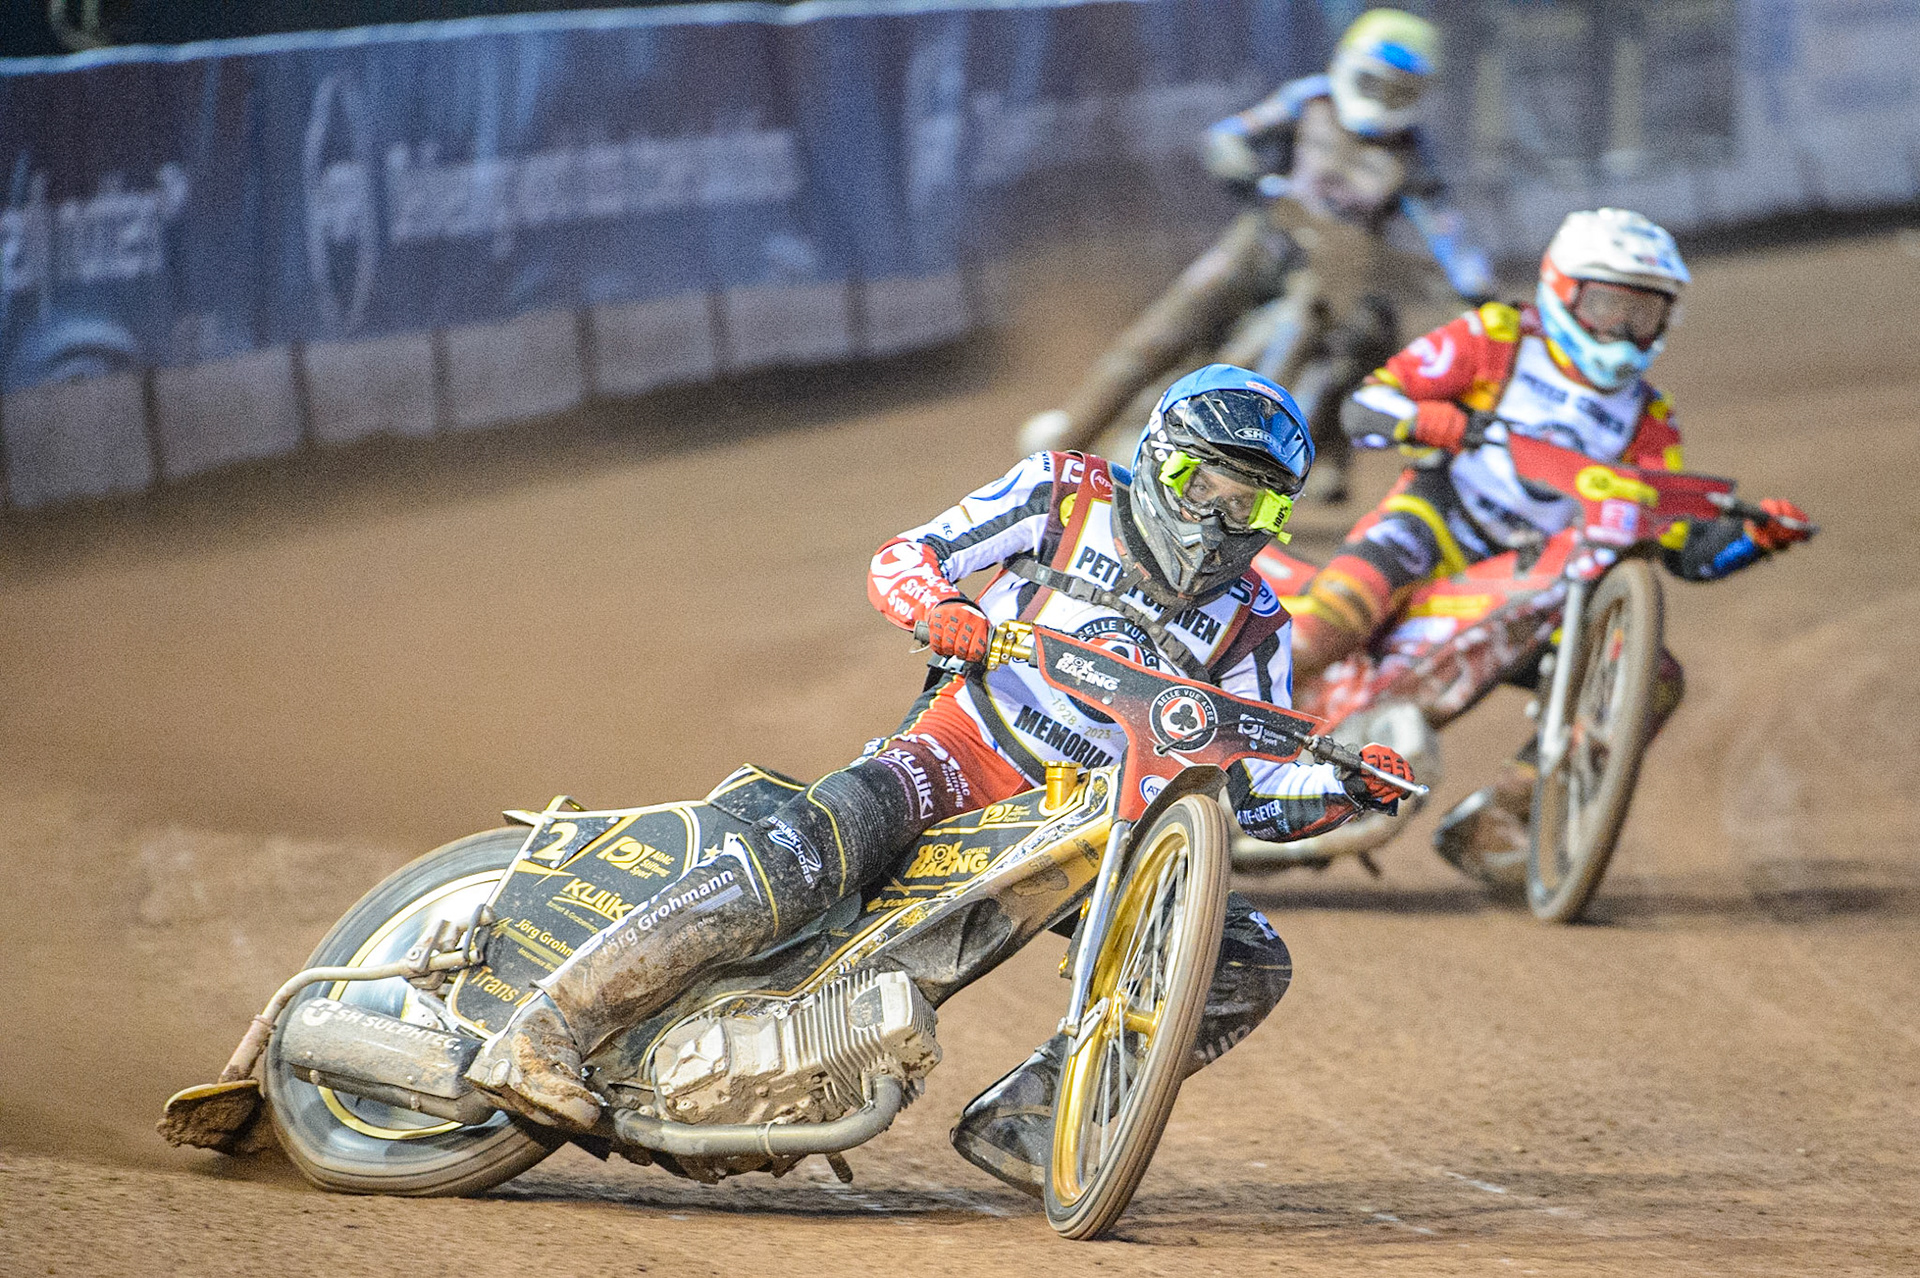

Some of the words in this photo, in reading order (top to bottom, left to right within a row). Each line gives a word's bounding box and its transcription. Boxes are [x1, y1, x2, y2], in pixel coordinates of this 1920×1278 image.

[1273, 505, 1289, 528] 100%
[1076, 546, 1124, 588] PET
[1124, 623, 1148, 644] VUE
[1055, 658, 1119, 691] RACING
[1051, 698, 1077, 727] 1928
[1083, 726, 1112, 740] 2023
[1156, 690, 1181, 707] BELLE
[1184, 690, 1202, 701] VUE
[1201, 700, 1215, 722] ACES
[531, 822, 578, 861] 2
[630, 866, 653, 879] Sport
[650, 850, 675, 866] ADAC
[903, 853, 989, 879] RACING
[562, 877, 635, 920] KULIK
[637, 869, 735, 931] Grohmann
[515, 919, 541, 940] Jörg
[470, 965, 519, 1002] Trans
